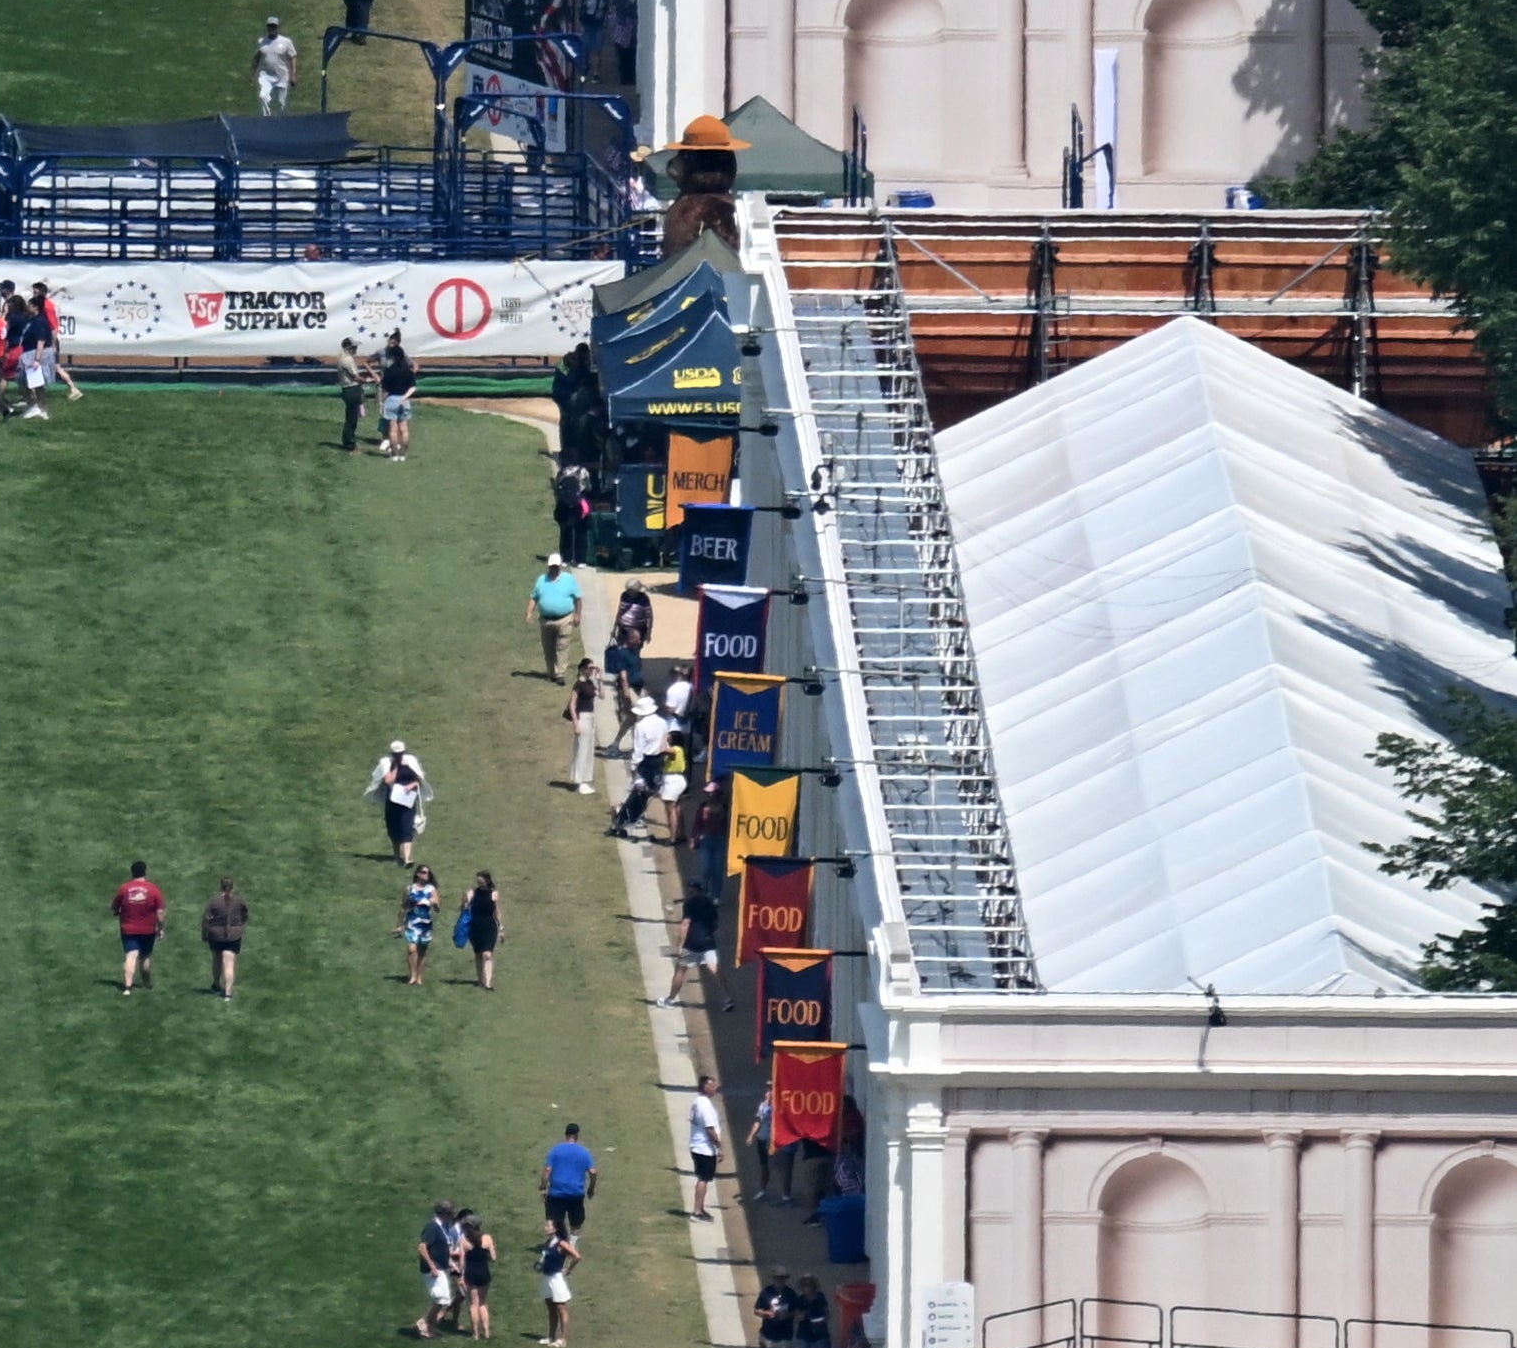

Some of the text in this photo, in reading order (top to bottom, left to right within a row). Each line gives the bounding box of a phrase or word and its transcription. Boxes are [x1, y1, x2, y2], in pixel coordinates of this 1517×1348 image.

[189, 296, 218, 321] TSC
[225, 291, 325, 310] TRACTOR
[116, 306, 150, 323] 250
[225, 311, 301, 330] SUPPLY
[362, 306, 398, 324] 250
[674, 368, 718, 381] USDA
[673, 472, 725, 492] MERCH
[690, 534, 738, 562] BEER
[704, 633, 757, 658] FOOD
[734, 711, 758, 732] ICE
[718, 731, 771, 752] CREAM
[736, 815, 788, 841] FOOD
[748, 904, 802, 932] FOOD
[767, 999, 821, 1026] FOOD
[780, 1090, 834, 1115] FOOD
